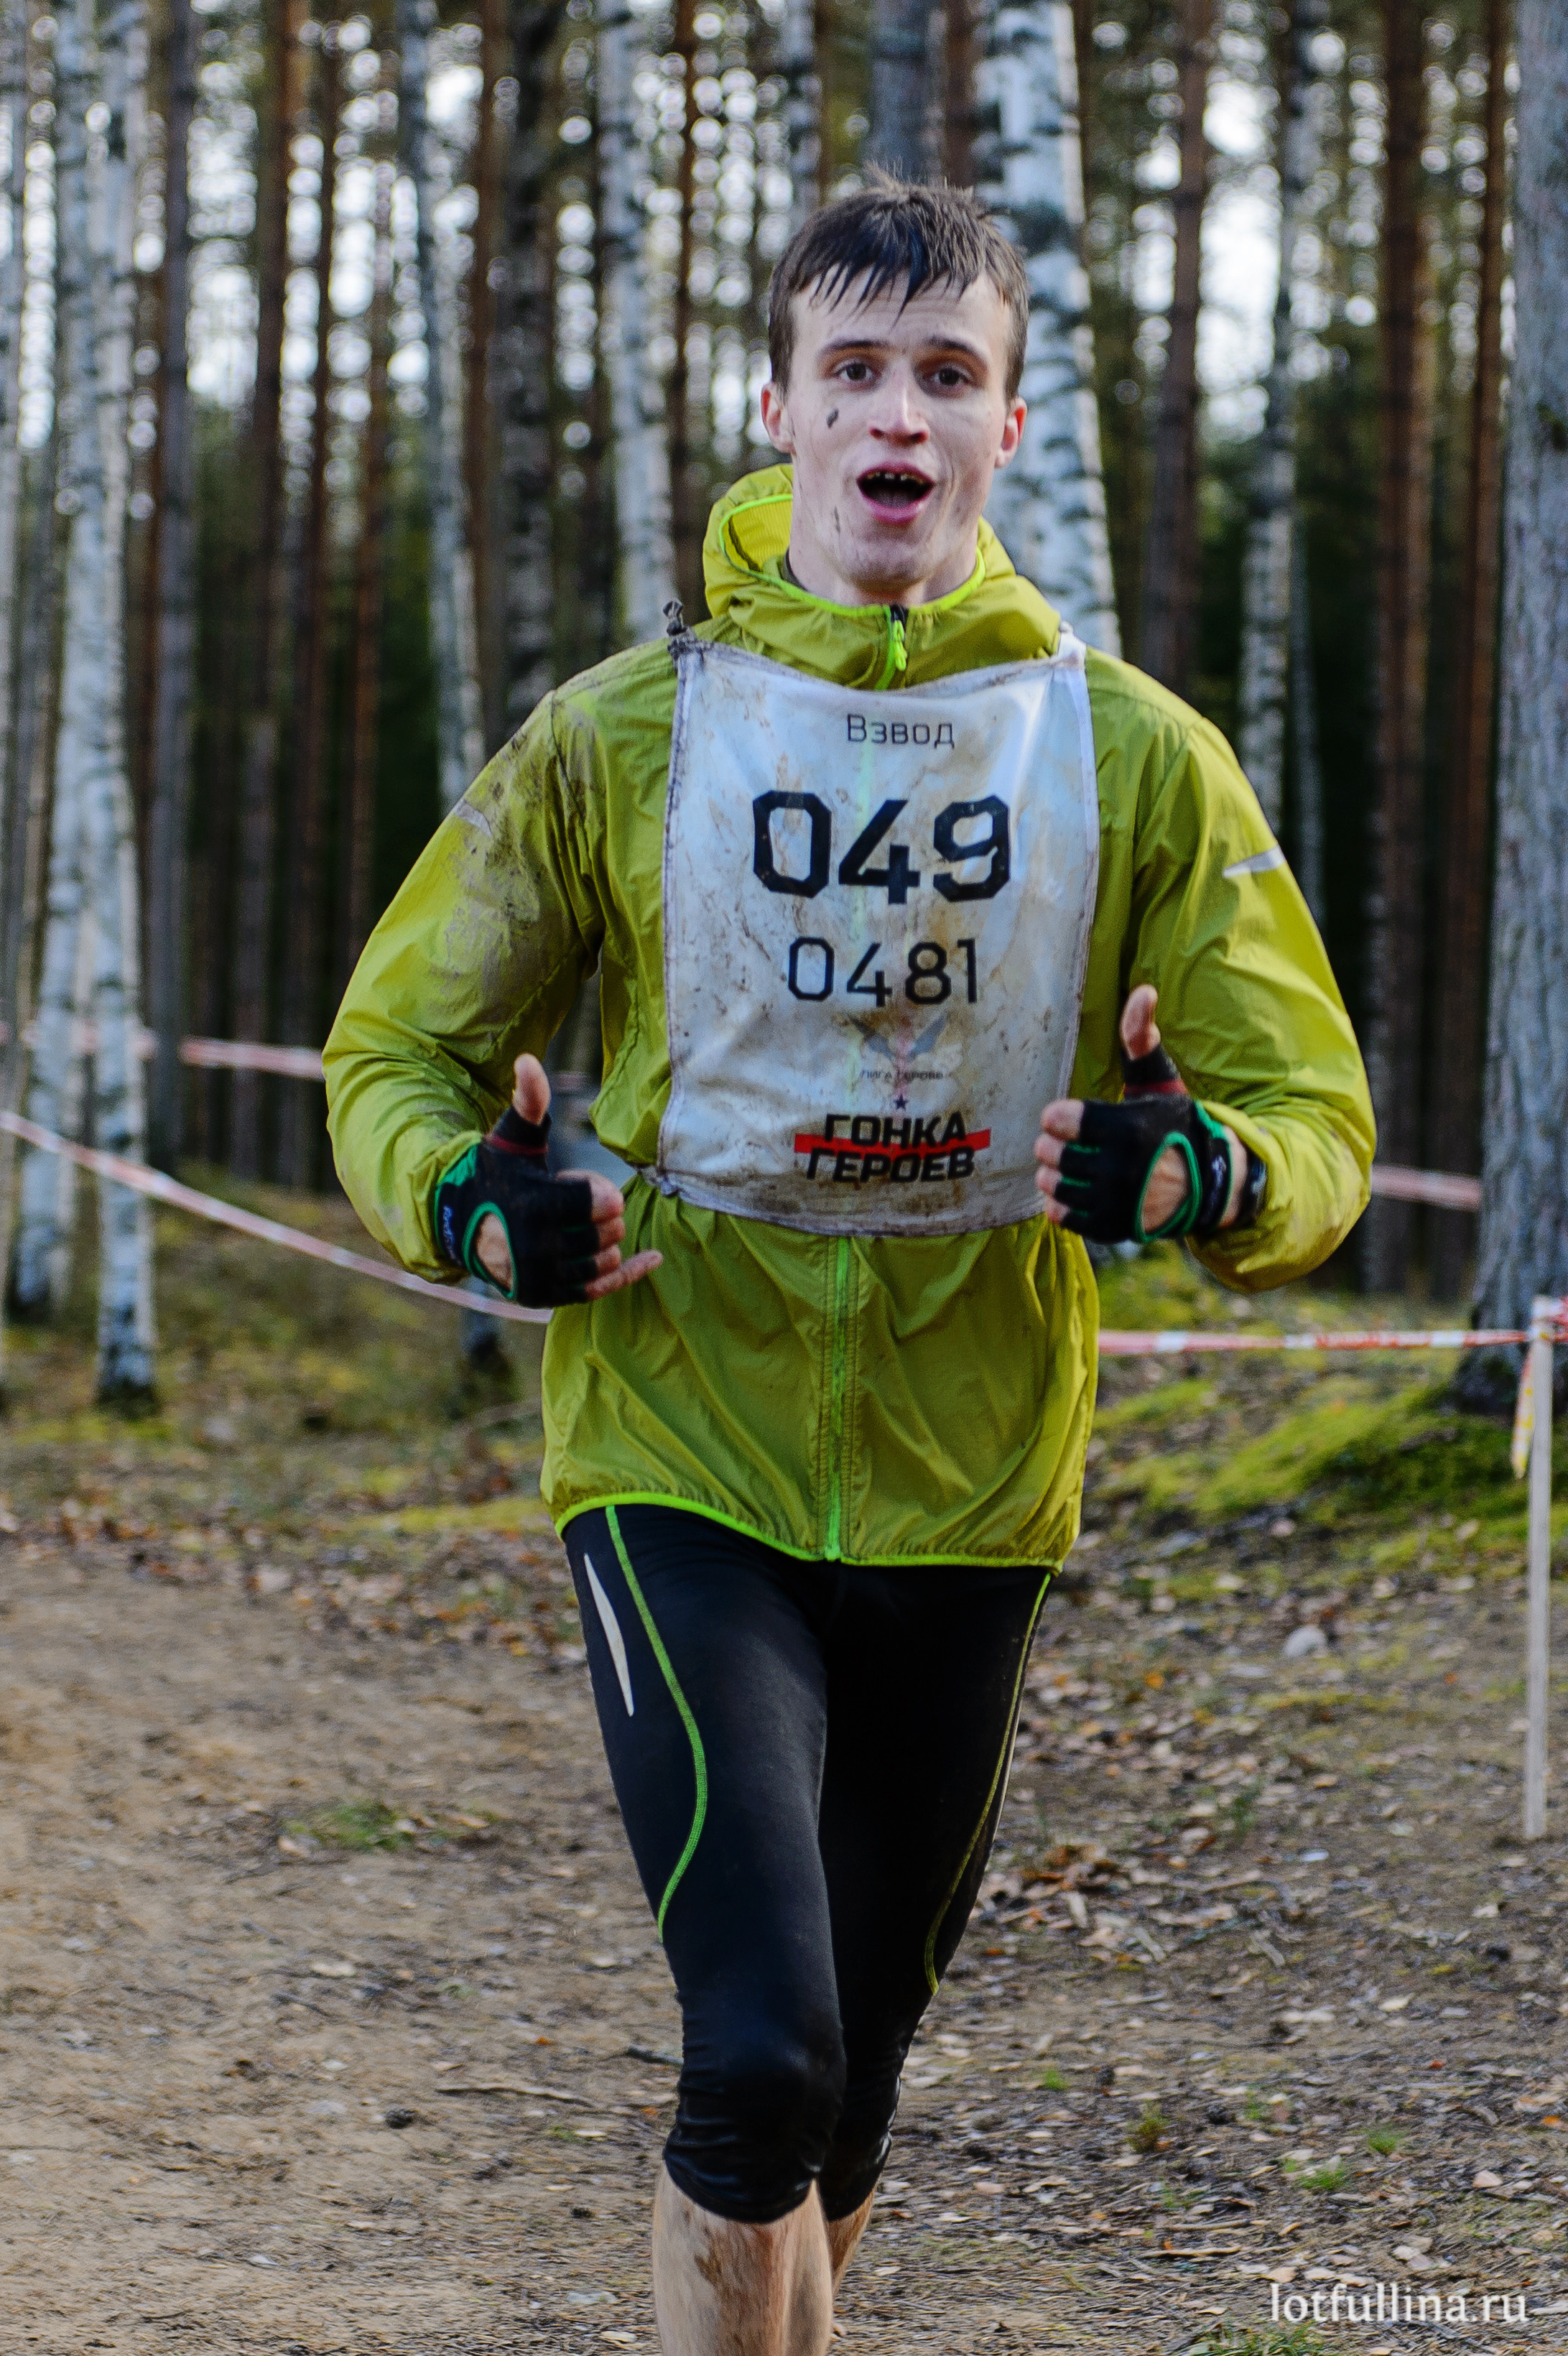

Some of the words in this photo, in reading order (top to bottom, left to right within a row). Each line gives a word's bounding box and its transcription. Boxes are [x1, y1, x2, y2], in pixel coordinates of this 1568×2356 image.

[847, 713, 955, 748] Взвод
[753, 790, 1010, 904] 049
[788, 937, 978, 1006] 0481
[825, 1111, 965, 1148] ГОНКА
[806, 1148, 975, 1183] ГЕРОЕВ
